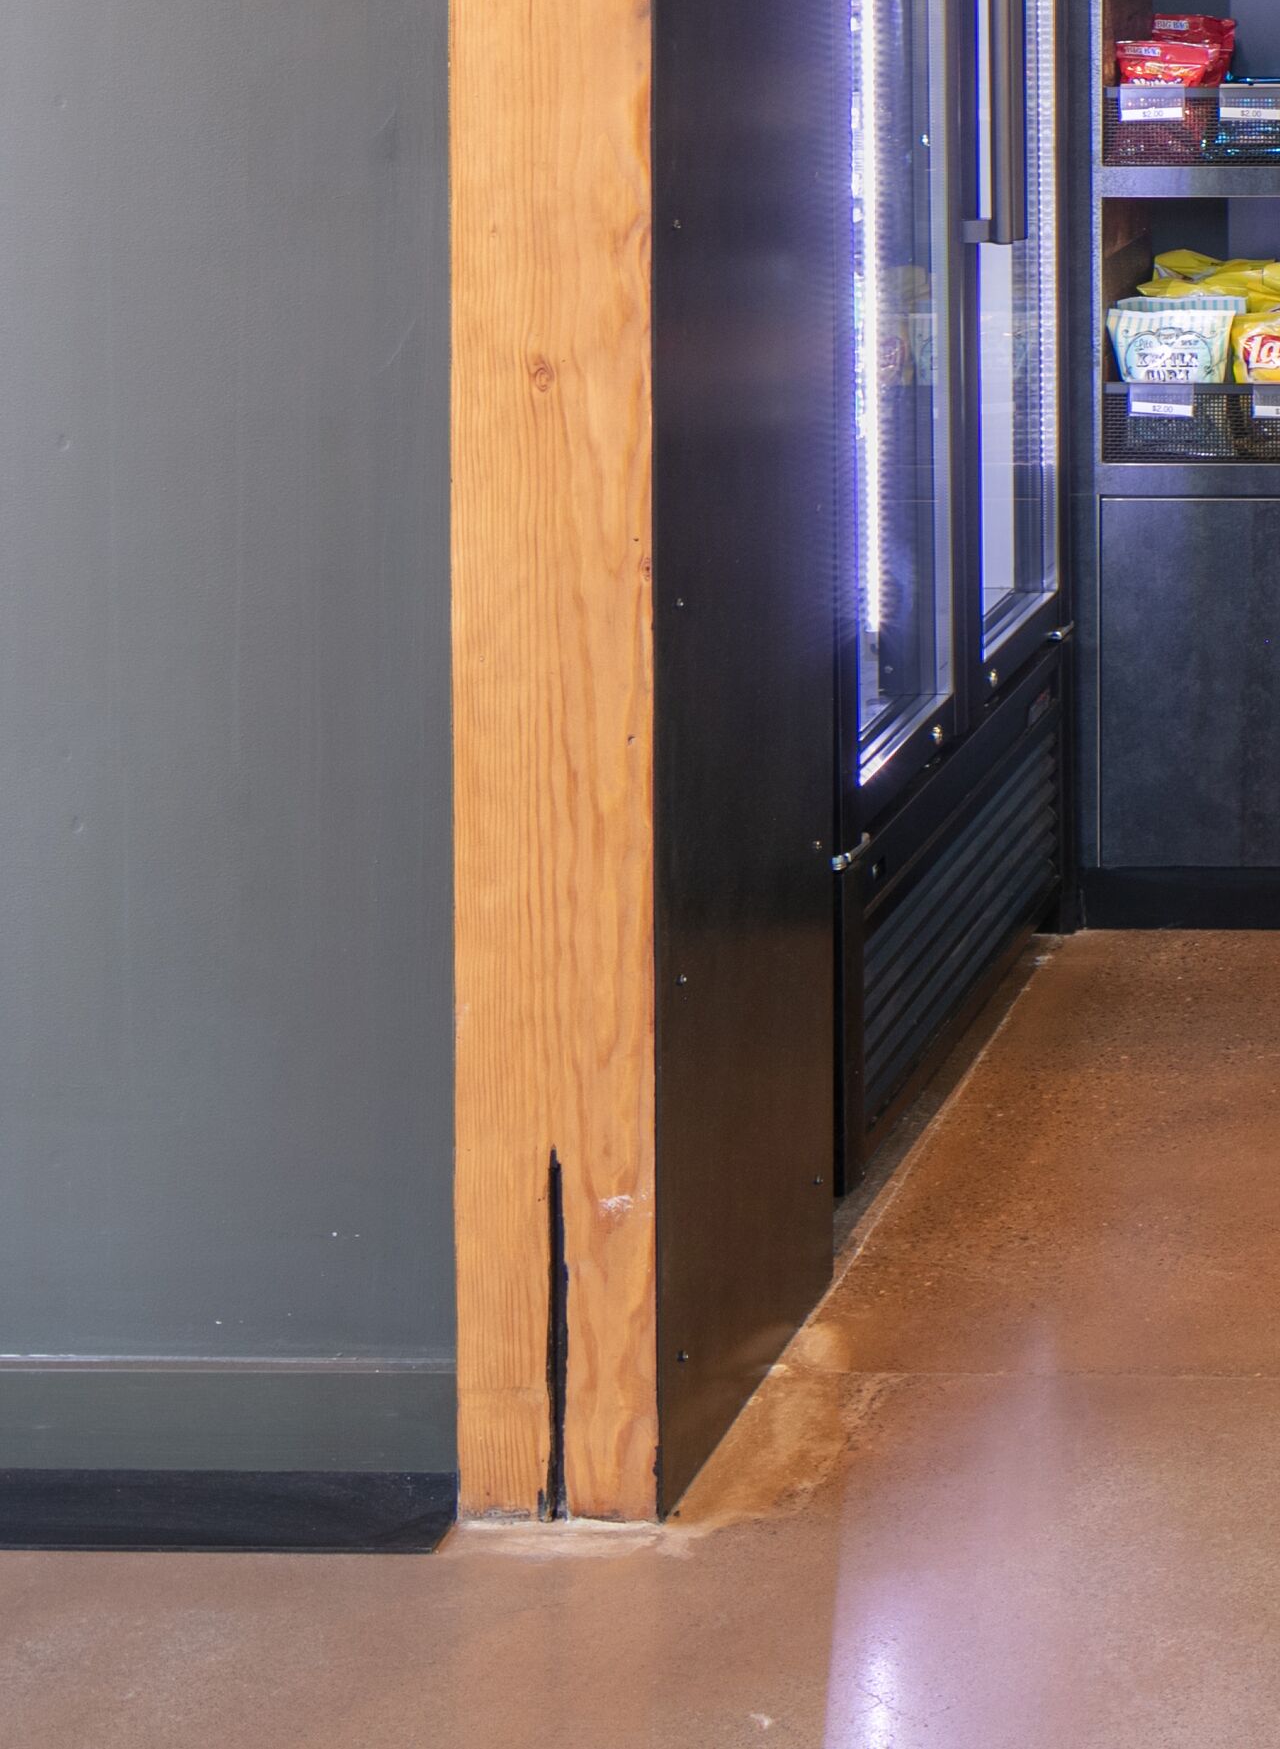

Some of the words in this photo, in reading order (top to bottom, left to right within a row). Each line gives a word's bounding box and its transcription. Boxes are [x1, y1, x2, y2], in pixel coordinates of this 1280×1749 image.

[1155, 20, 1171, 29] BIG
[1240, 109, 1262, 118] $2.00
[1152, 405, 1173, 413] $2.00
